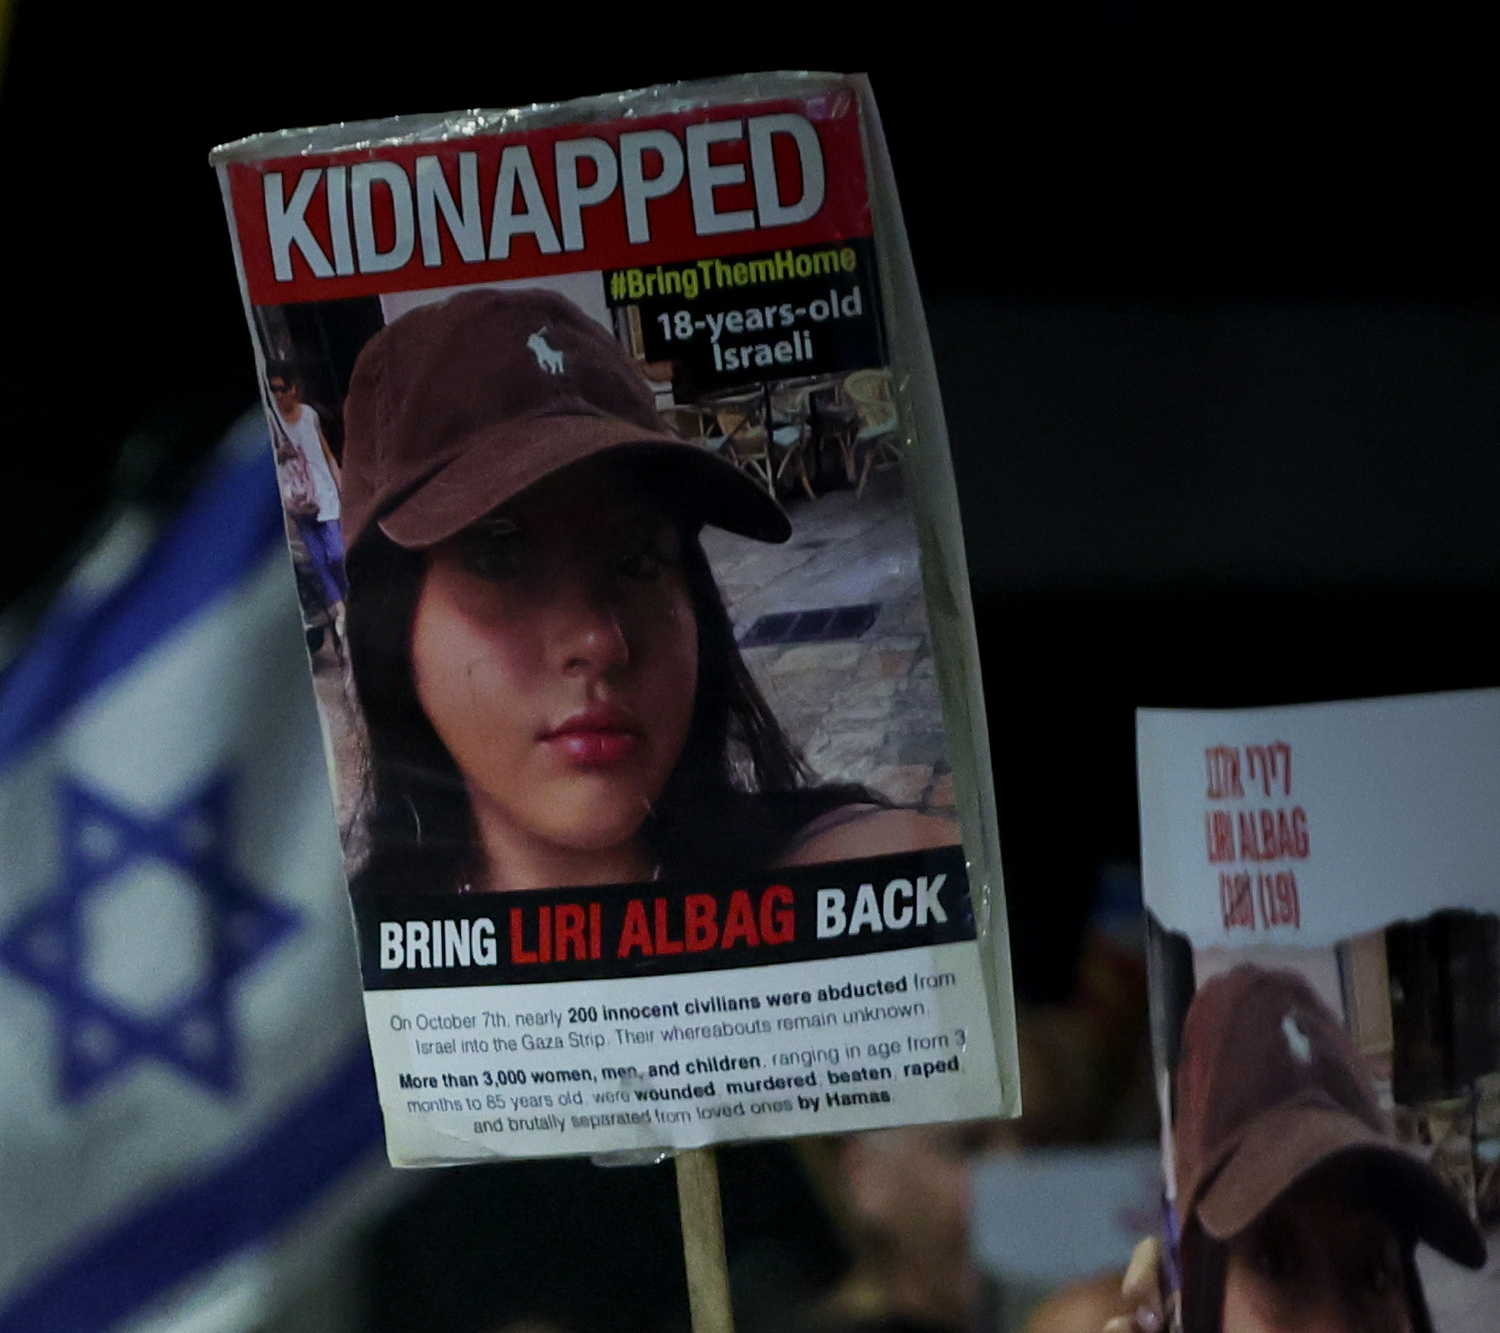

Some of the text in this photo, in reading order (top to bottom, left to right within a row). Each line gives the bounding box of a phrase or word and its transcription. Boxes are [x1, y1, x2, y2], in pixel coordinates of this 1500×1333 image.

[262, 112, 827, 284] KIDNAPPED
[610, 246, 858, 301] #BringThemHome
[657, 287, 863, 345] 18-years-old
[713, 335, 814, 373] Israeli
[380, 874, 948, 970] BRING LIRI ALBAG BACK
[390, 1014, 412, 1031] On
[415, 1012, 477, 1030] October
[515, 1008, 563, 1028] nearly
[568, 1006, 598, 1023] 200
[602, 1001, 680, 1021] innocent
[684, 994, 761, 1016] civilians
[766, 991, 812, 1006] were
[817, 975, 908, 1001] abducted
[913, 971, 956, 991] from
[399, 1073, 439, 1090] More
[441, 1071, 479, 1088] than
[483, 1070, 527, 1089] 3,000
[531, 1067, 598, 1085] women,
[648, 1062, 680, 1078] and
[771, 1046, 841, 1068] ranging
[845, 1042, 861, 1059] in
[867, 1040, 902, 1059] age
[906, 1034, 950, 1053] from
[955, 1029, 966, 1047] 3
[415, 1038, 457, 1055] Israel
[461, 1038, 489, 1053] into
[493, 1036, 517, 1052] the
[522, 1034, 565, 1050] Gaza
[616, 1028, 655, 1045] Their
[660, 1019, 772, 1042] whereabouts
[777, 1011, 838, 1031] remain
[407, 1098, 463, 1113] months
[466, 1097, 482, 1111] to
[486, 1094, 506, 1110] 85
[510, 1094, 553, 1112] years
[473, 1117, 504, 1134] and
[508, 1112, 566, 1133] brutally
[797, 1092, 820, 1112] by
